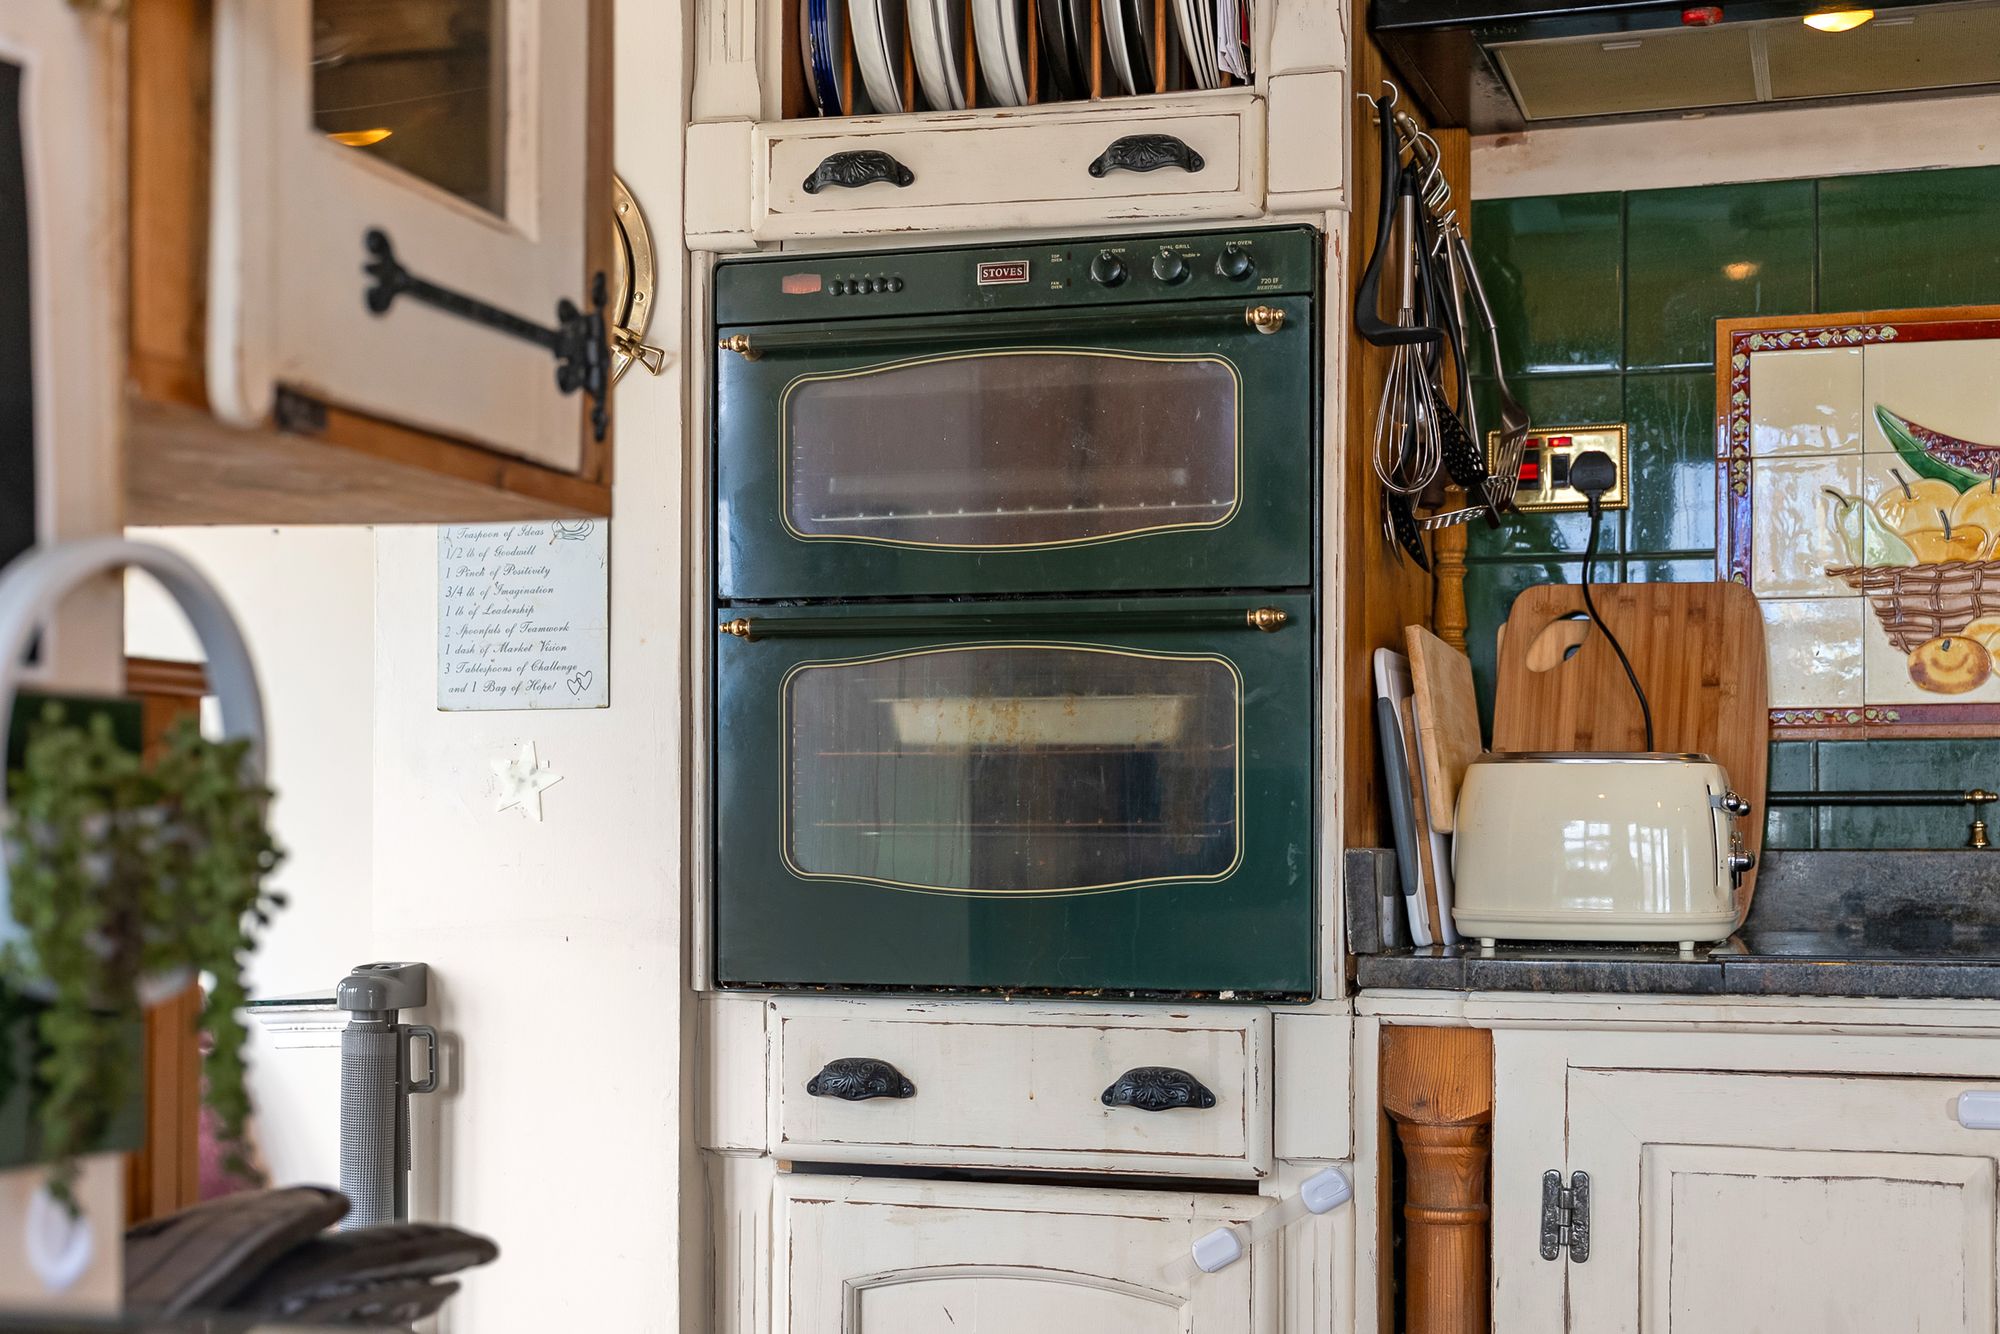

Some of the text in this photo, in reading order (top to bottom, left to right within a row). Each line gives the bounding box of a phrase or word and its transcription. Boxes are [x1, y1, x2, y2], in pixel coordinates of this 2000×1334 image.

[983, 267, 1023, 278] STOVES
[457, 527, 499, 542] Teaspoon
[503, 526, 516, 541] of
[517, 524, 544, 536] Ideas
[446, 545, 537, 561] 1/2 lb of Goodwill
[446, 563, 550, 580] 1 Pinch of Positivity
[445, 583, 554, 600] 3/4 lb of Imagination
[445, 603, 535, 620] 1 lb of Leadership
[444, 621, 569, 639] 2 Spoonfuls of Teamwork
[445, 640, 567, 657] 1 dash of Market Vision
[444, 659, 578, 676] 3 Tablespoons of Challenge
[448, 679, 557, 696] and 1 Bag of Hope!
